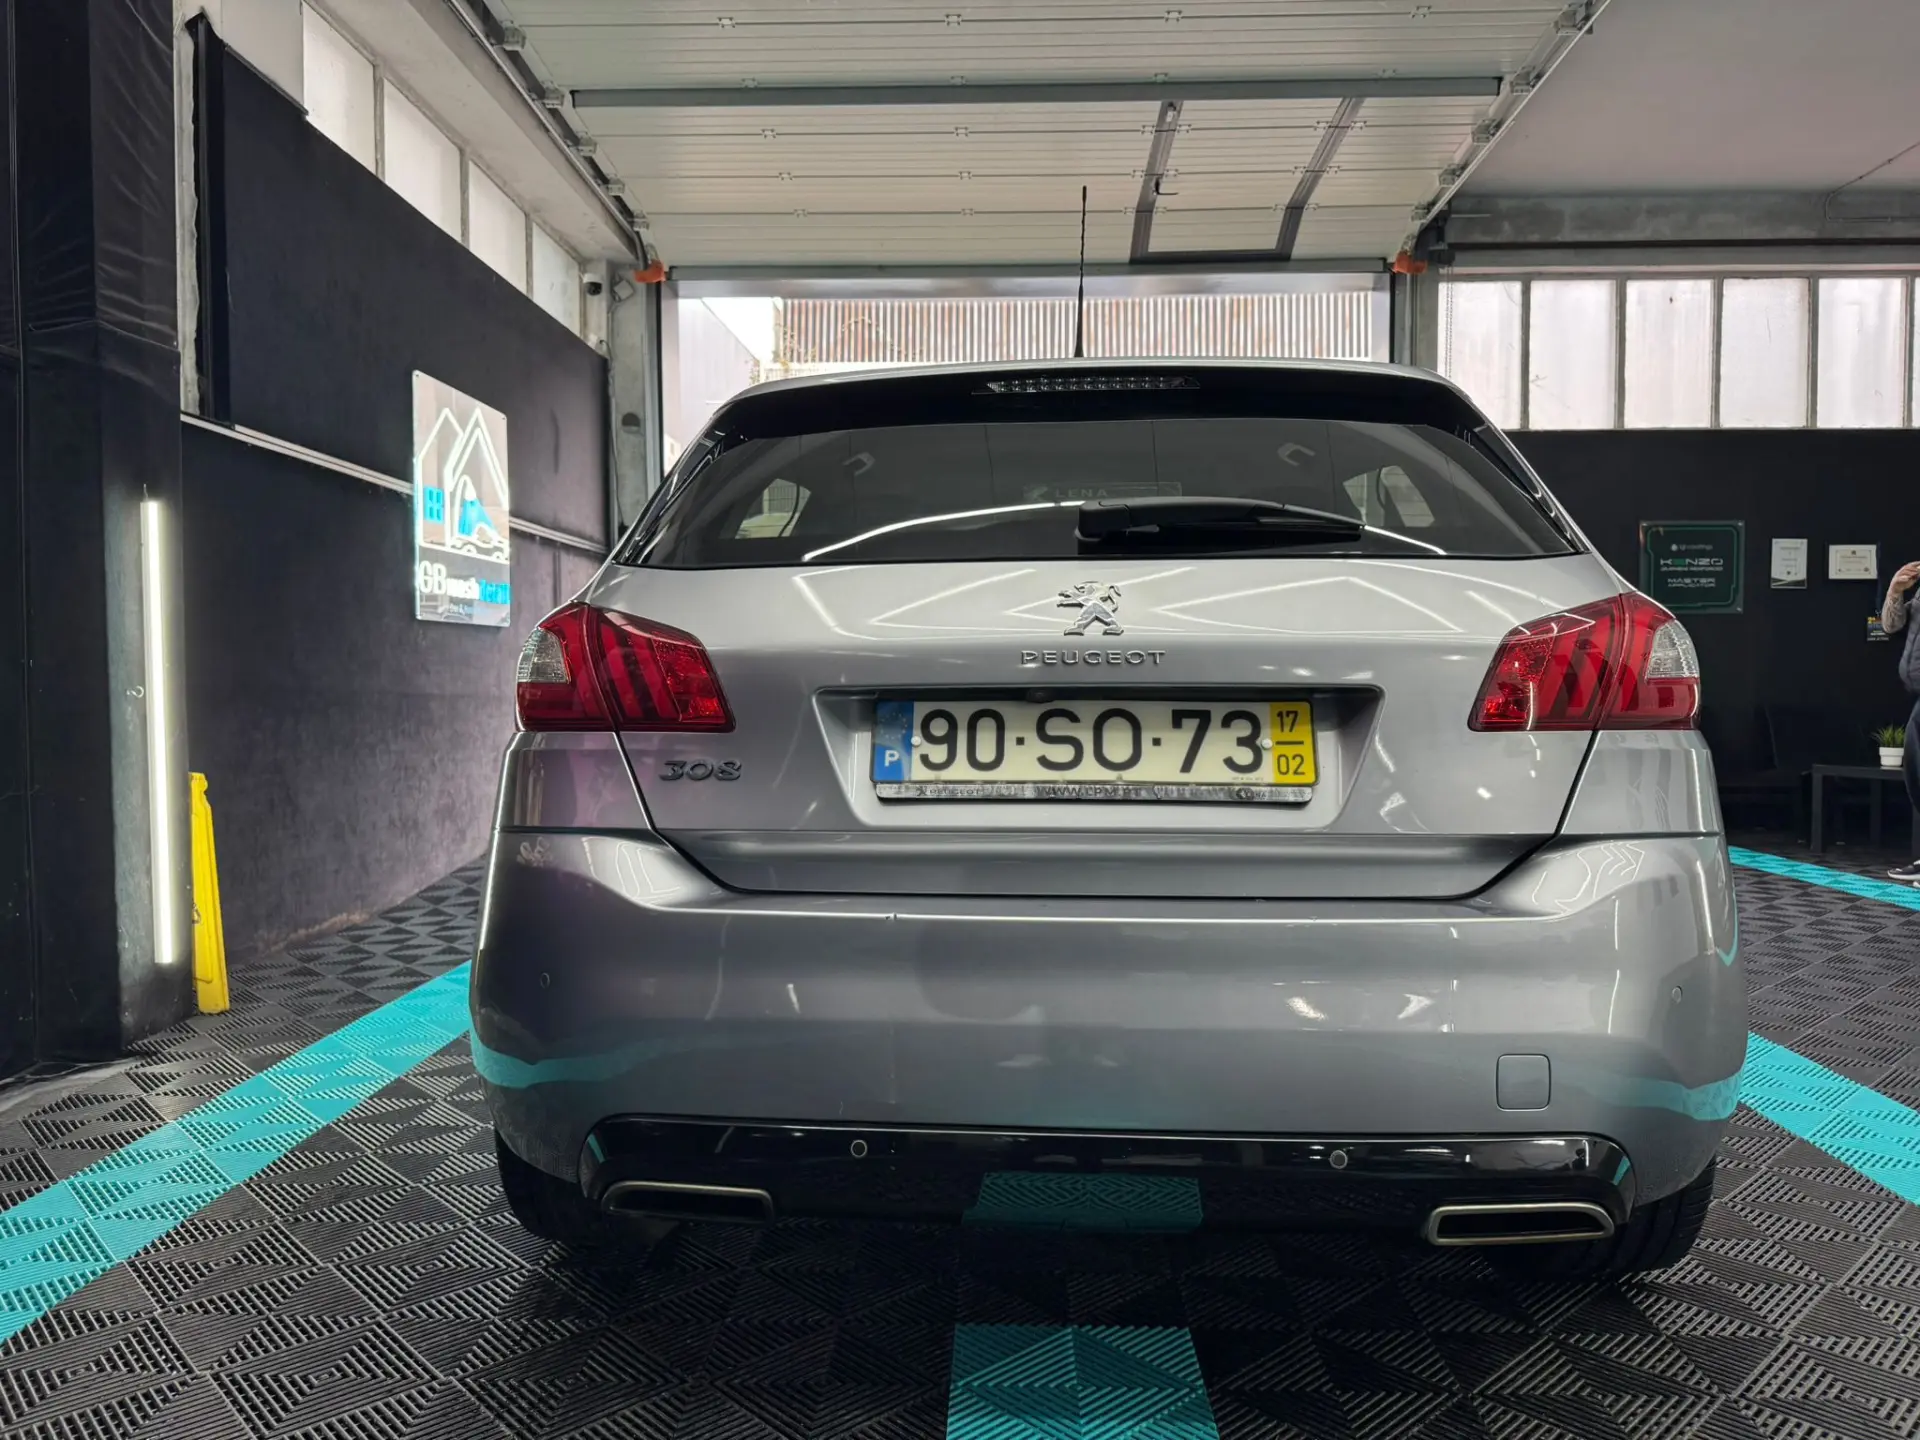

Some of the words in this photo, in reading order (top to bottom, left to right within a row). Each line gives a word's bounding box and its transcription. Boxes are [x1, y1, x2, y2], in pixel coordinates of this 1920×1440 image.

[1055, 488, 1109, 498] LENA
[1020, 649, 1167, 665] PEUGEOT
[1276, 709, 1300, 733] 17
[883, 750, 900, 767] P
[1276, 753, 1306, 776] 02
[658, 760, 742, 781] 308
